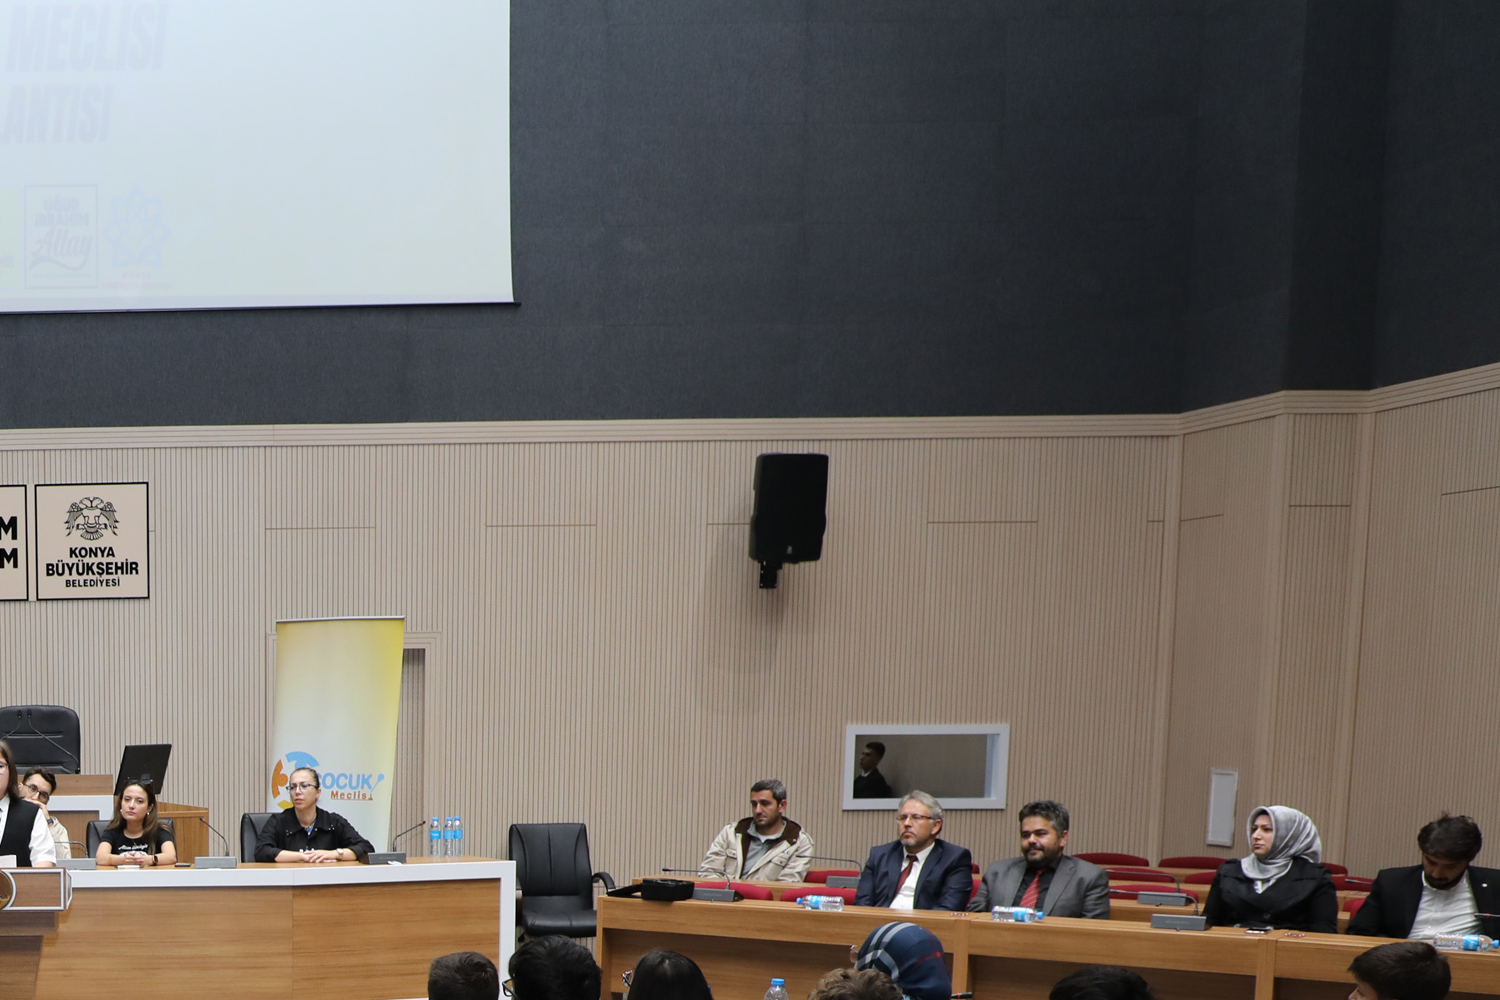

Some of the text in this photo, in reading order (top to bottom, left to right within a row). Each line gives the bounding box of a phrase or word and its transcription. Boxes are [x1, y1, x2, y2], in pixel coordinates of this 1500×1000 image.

[69, 546, 115, 558] KONYA
[46, 559, 139, 577] BÜYÜKŞEHİR
[65, 577, 120, 588] BELEDİYESİ
[318, 772, 373, 790] OCUK
